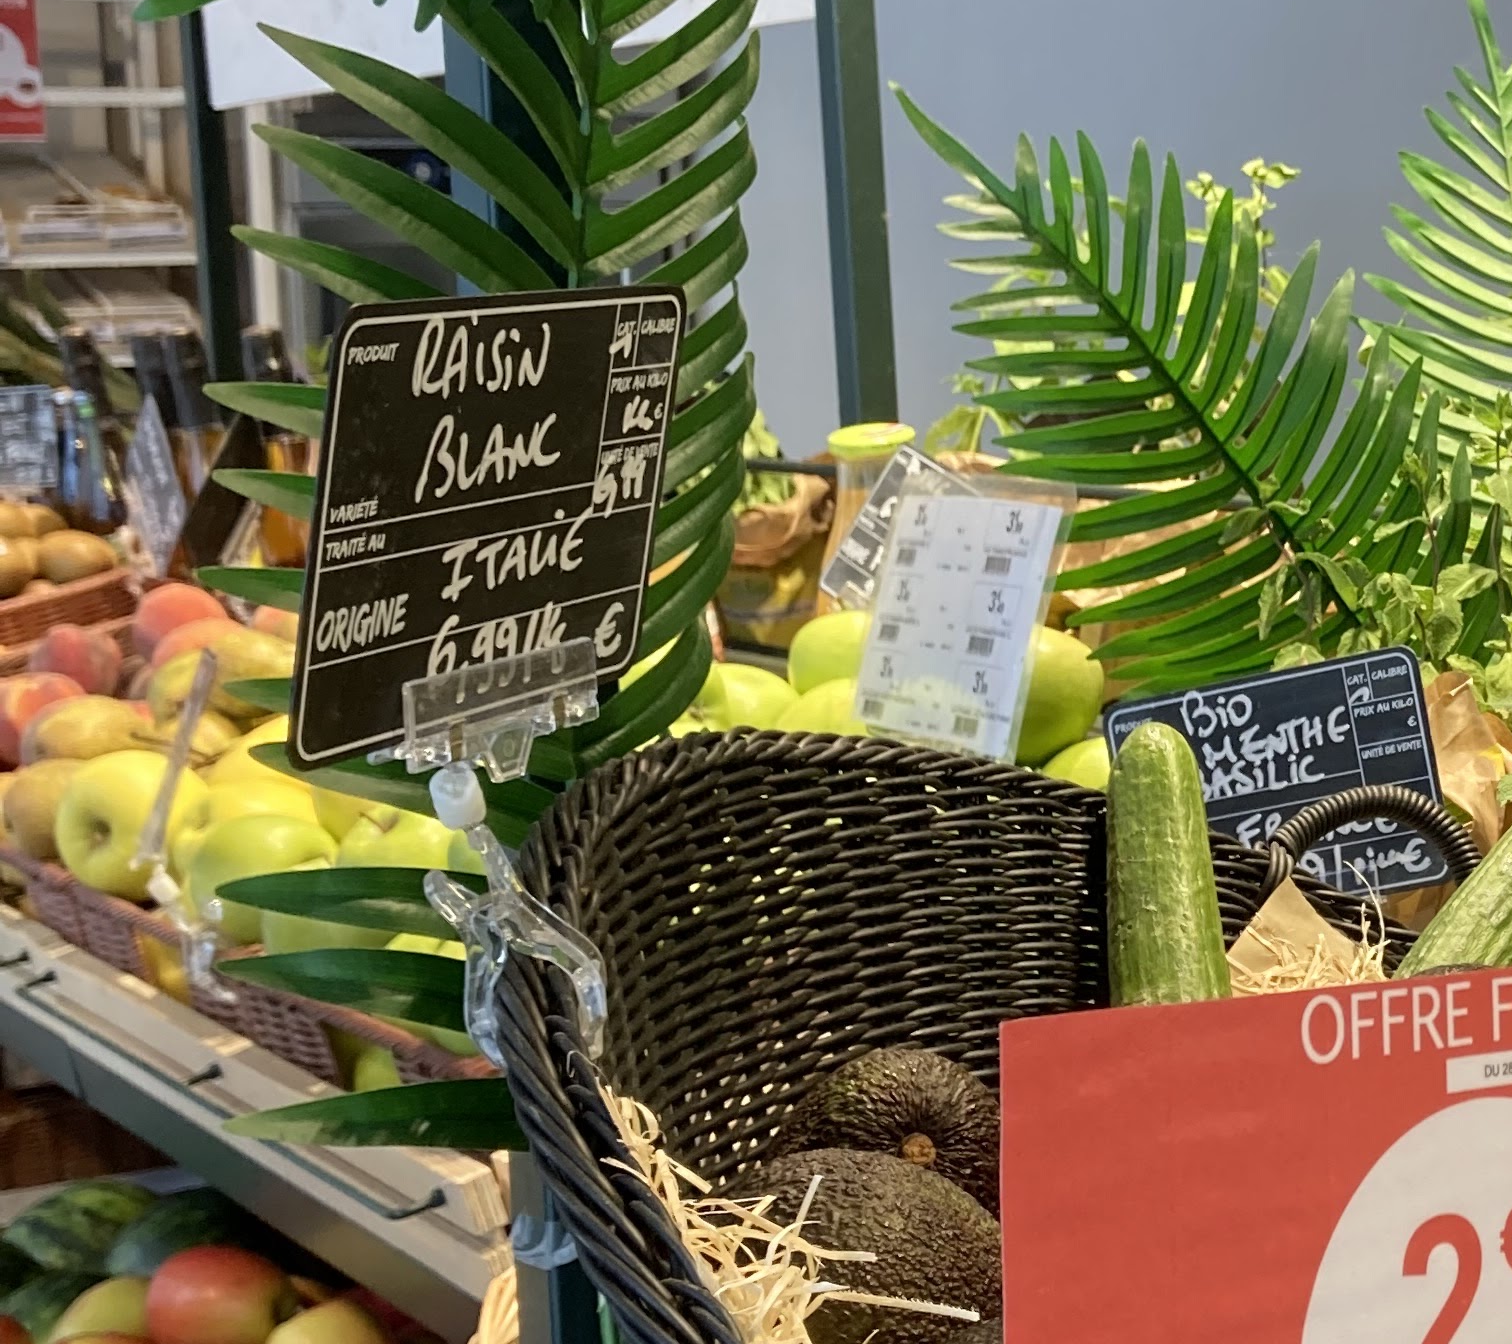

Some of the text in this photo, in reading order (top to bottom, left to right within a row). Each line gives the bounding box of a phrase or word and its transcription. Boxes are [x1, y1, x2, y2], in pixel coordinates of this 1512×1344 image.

[640, 317, 677, 336] CALIBRE
[347, 340, 401, 367] PRODUIT
[413, 411, 563, 505] BLANC
[328, 494, 380, 525] VARIÉTÉ
[325, 532, 388, 562] TRAITÉ AU
[315, 592, 410, 654] ORIGINE
[594, 601, 626, 659] €
[1346, 673, 1369, 686] CAT.
[1371, 664, 1409, 681] CALIBRE
[1353, 696, 1415, 718] PRIX AU KILO
[1201, 704, 1352, 771] MENTHE
[1384, 743, 1397, 756] DE
[1397, 739, 1423, 754] VENTE
[1301, 980, 1474, 1066] OFFRE
[1483, 1060, 1501, 1080] DU
